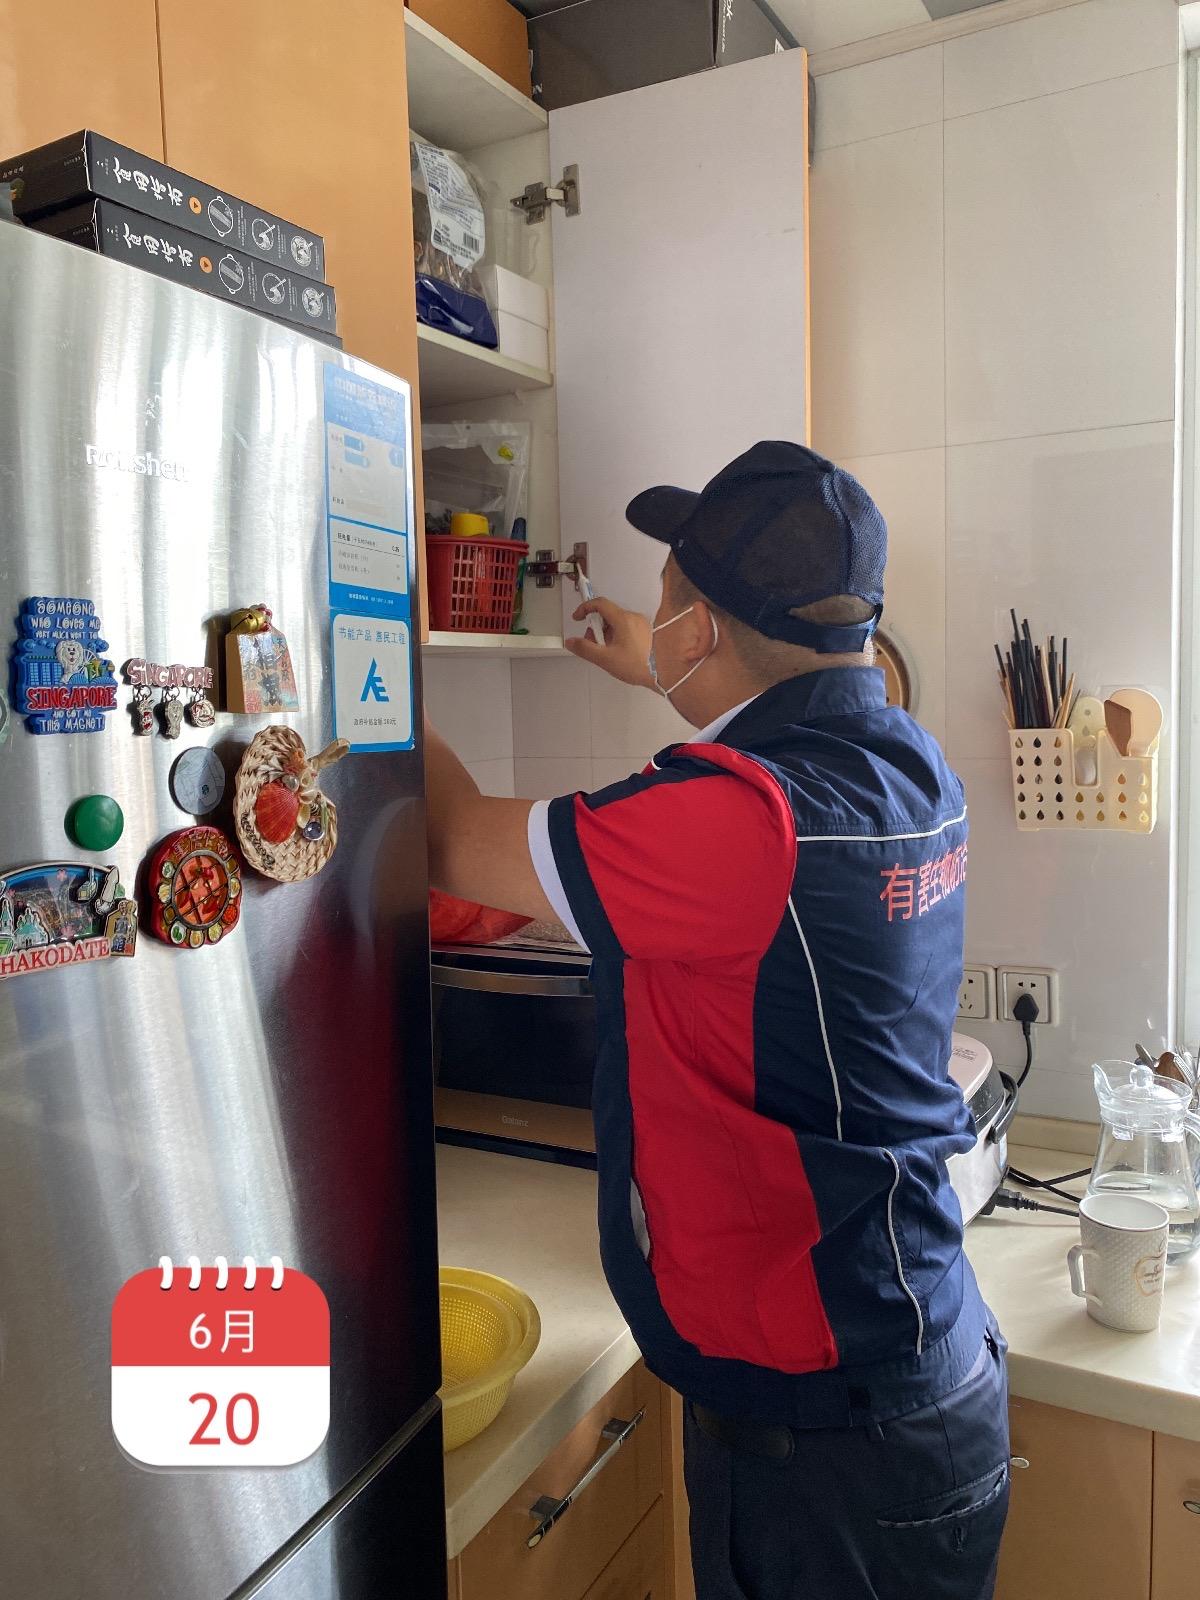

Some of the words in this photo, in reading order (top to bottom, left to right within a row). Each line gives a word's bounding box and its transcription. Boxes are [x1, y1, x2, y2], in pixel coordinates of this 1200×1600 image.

[37, 601, 95, 616] SOMEONE
[31, 617, 51, 630] WHO
[57, 617, 84, 630] LOVES
[339, 627, 372, 641] 节能产品
[376, 631, 406, 645] 惠民工程
[127, 658, 214, 689] SINGAPORE
[27, 686, 117, 711] SINGAPORE
[40, 719, 60, 732] THIS
[0, 938, 110, 976] HAKODATE
